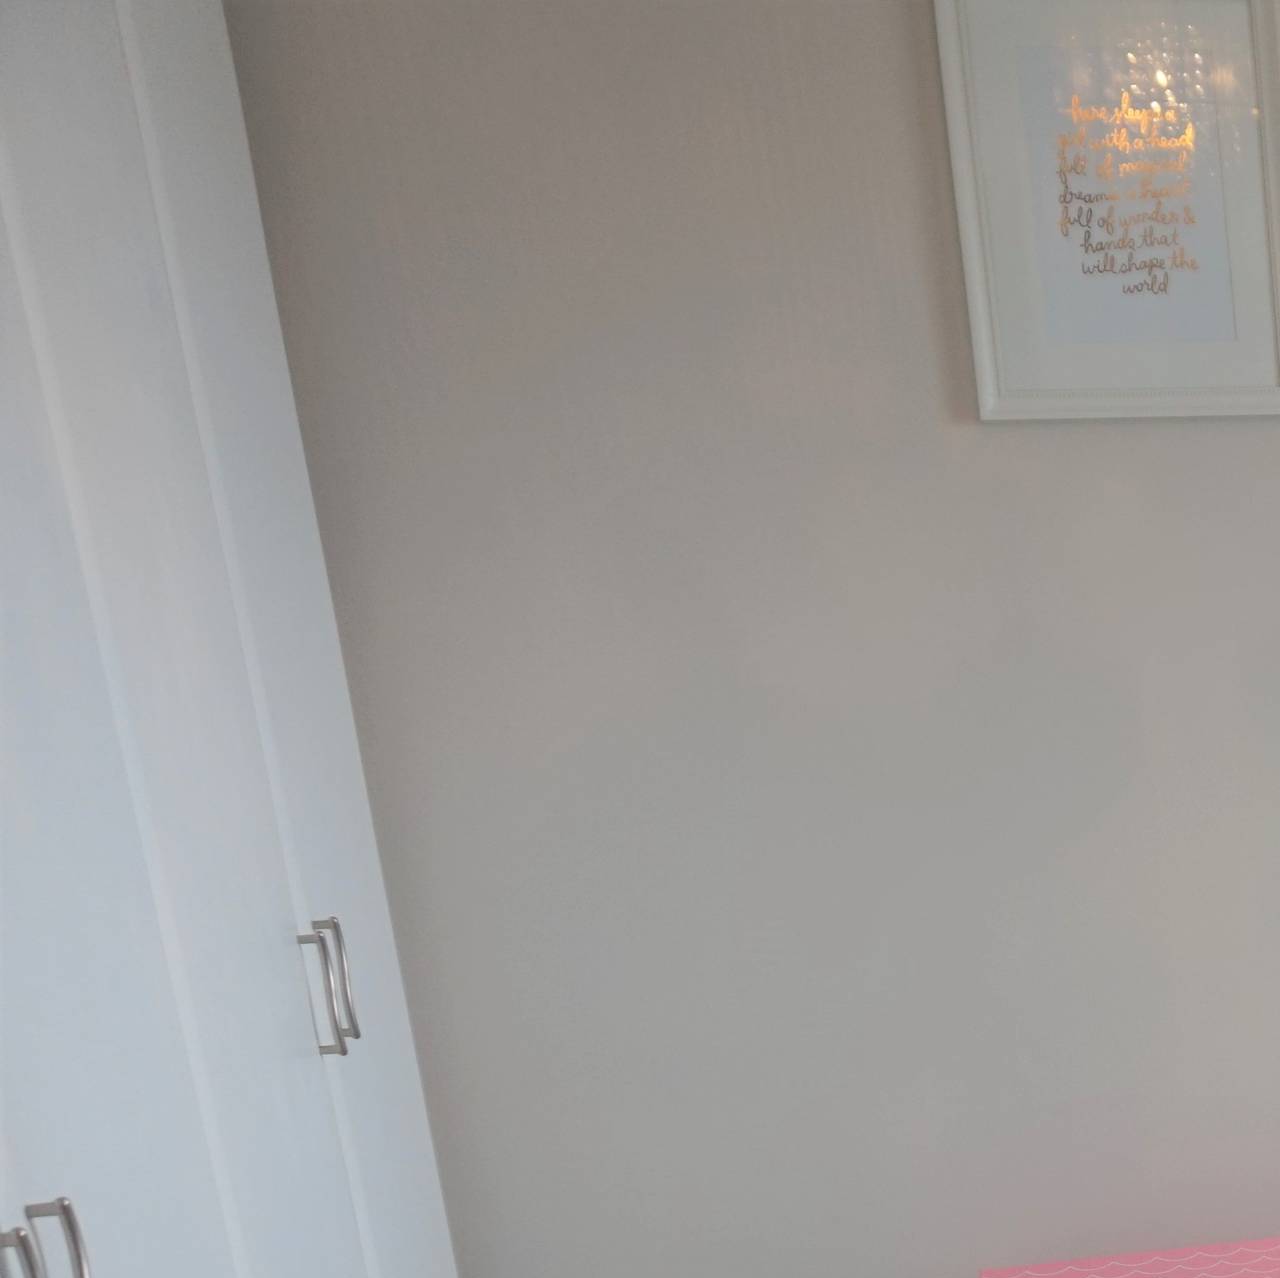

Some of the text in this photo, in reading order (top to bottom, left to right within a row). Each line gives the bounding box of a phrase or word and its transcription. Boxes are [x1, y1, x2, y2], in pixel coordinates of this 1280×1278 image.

[1056, 205, 1094, 237] full
[1096, 205, 1115, 235] of
[1080, 226, 1180, 255] hands that
[1081, 248, 1200, 277] will shape the
[1121, 272, 1170, 295] world
